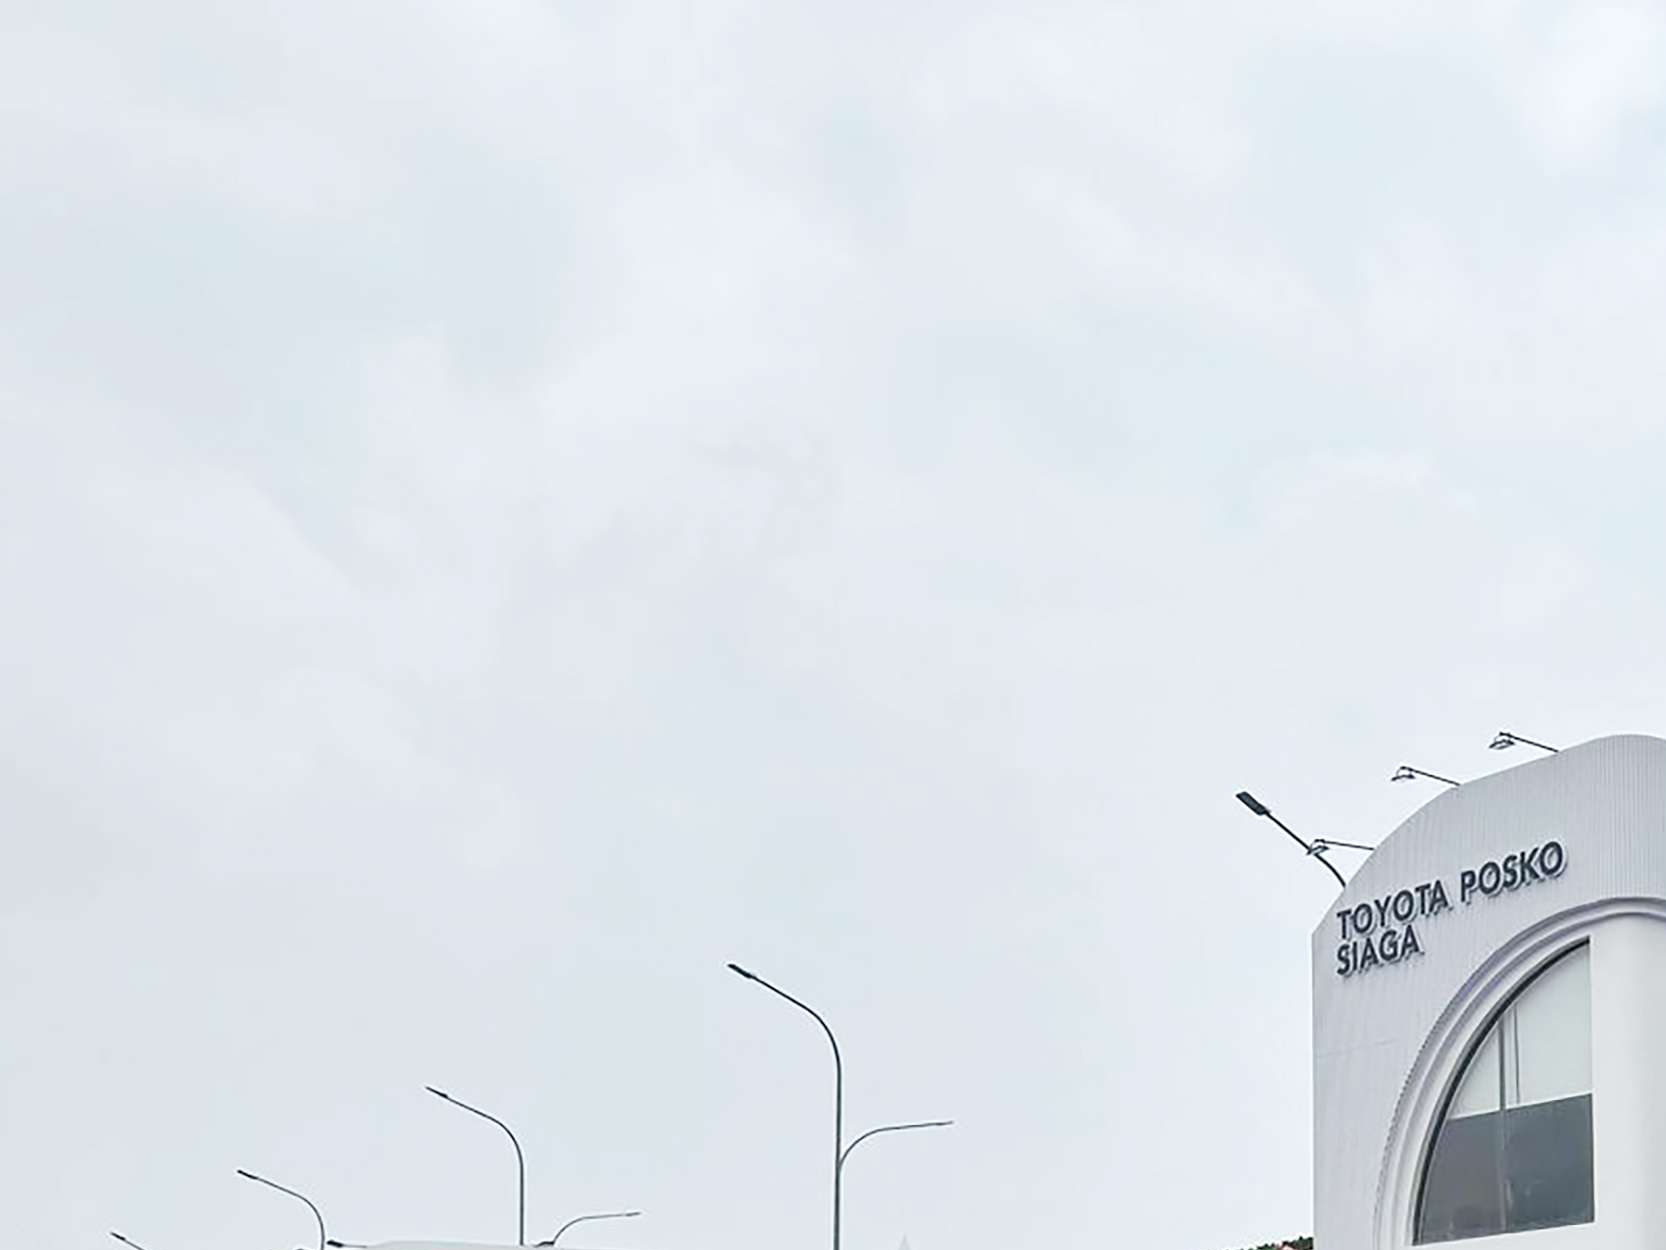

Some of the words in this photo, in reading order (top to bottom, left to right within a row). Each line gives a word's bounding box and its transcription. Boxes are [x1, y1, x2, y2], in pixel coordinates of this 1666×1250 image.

[1337, 880, 1449, 939] TOYOTA
[1461, 841, 1564, 902] POSKO
[1337, 925, 1420, 975] SIAGA
